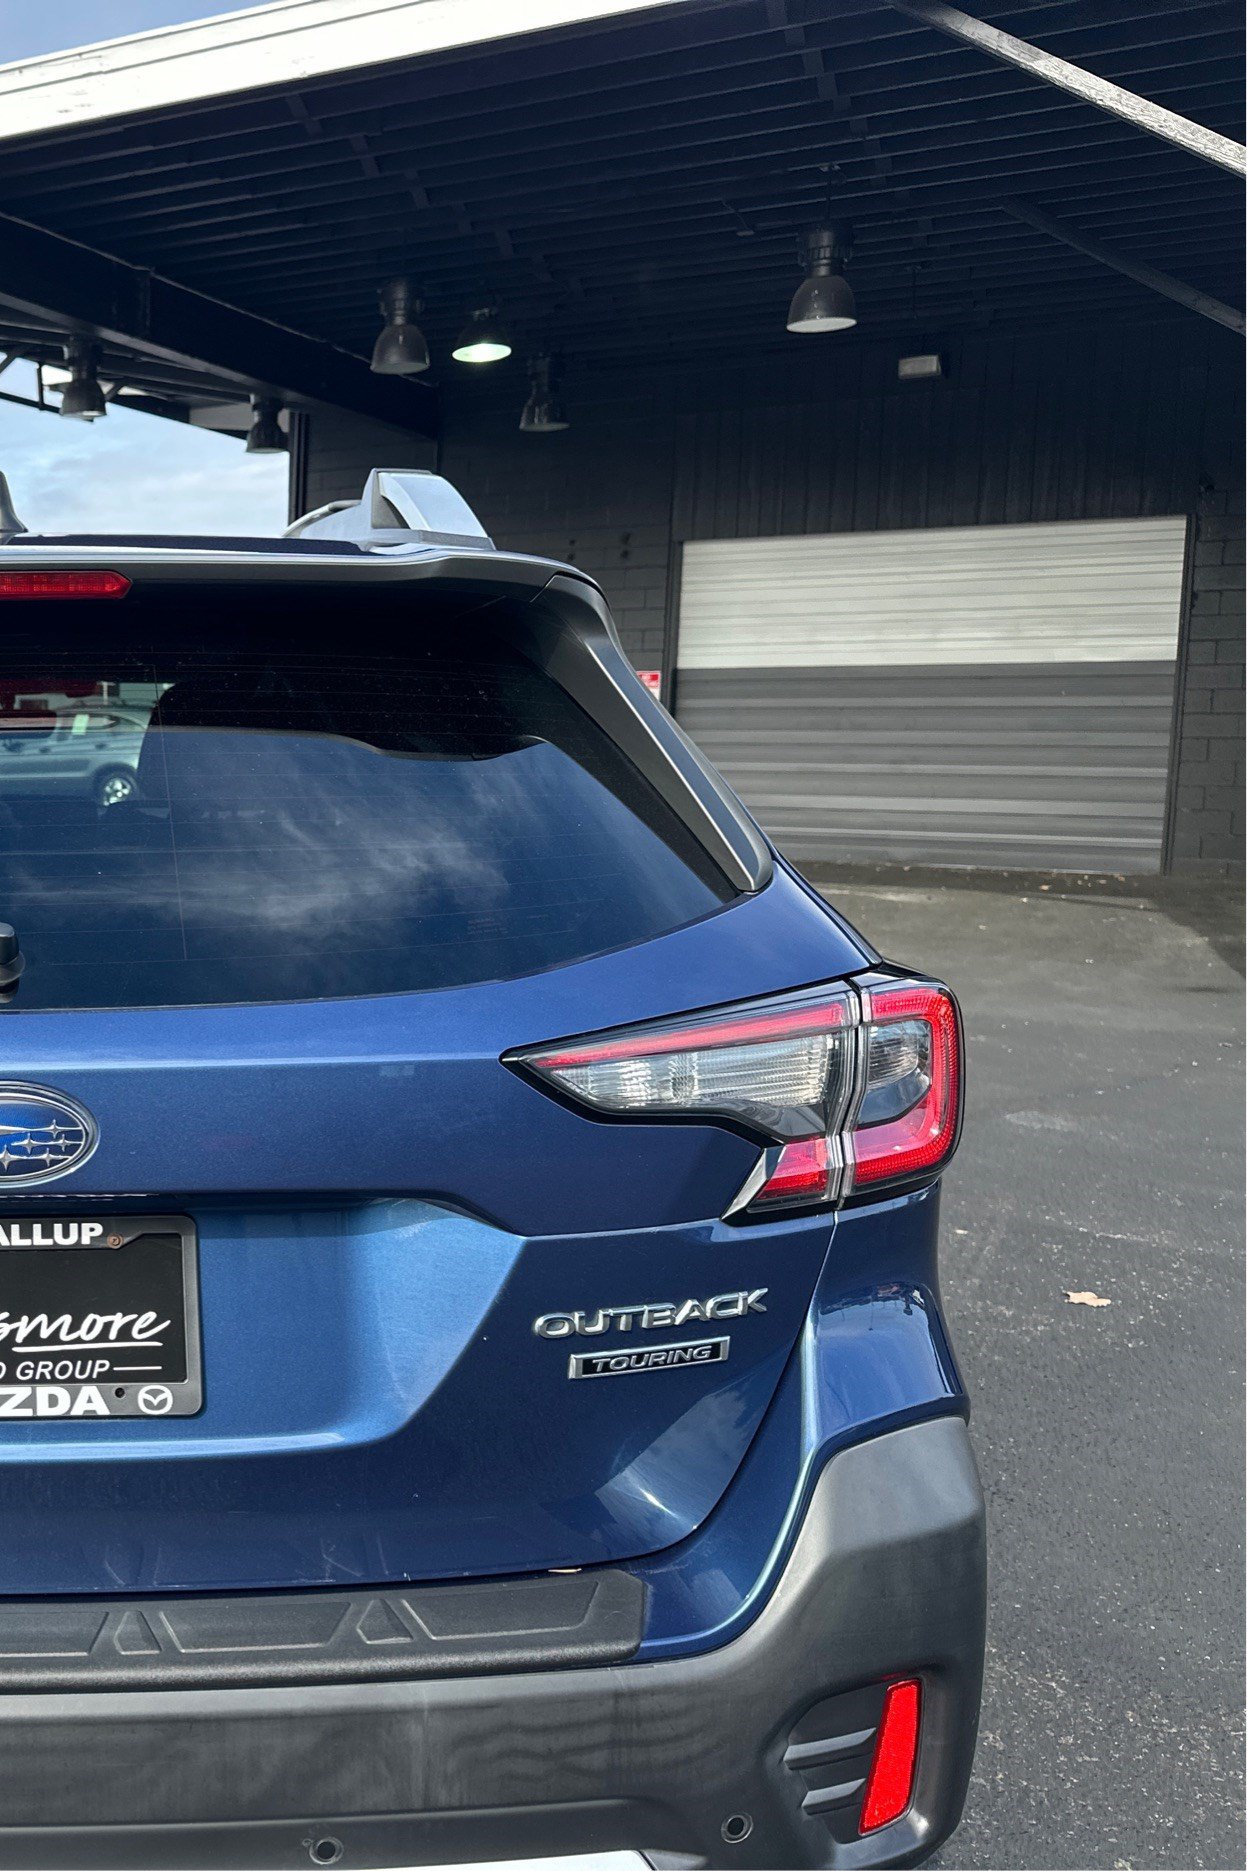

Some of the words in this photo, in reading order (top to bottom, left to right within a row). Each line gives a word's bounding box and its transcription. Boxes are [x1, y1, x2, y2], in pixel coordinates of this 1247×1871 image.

[533, 1287, 769, 1338] OUTBACK
[16, 1359, 110, 1380] GROUP
[592, 1345, 713, 1373] TOURING
